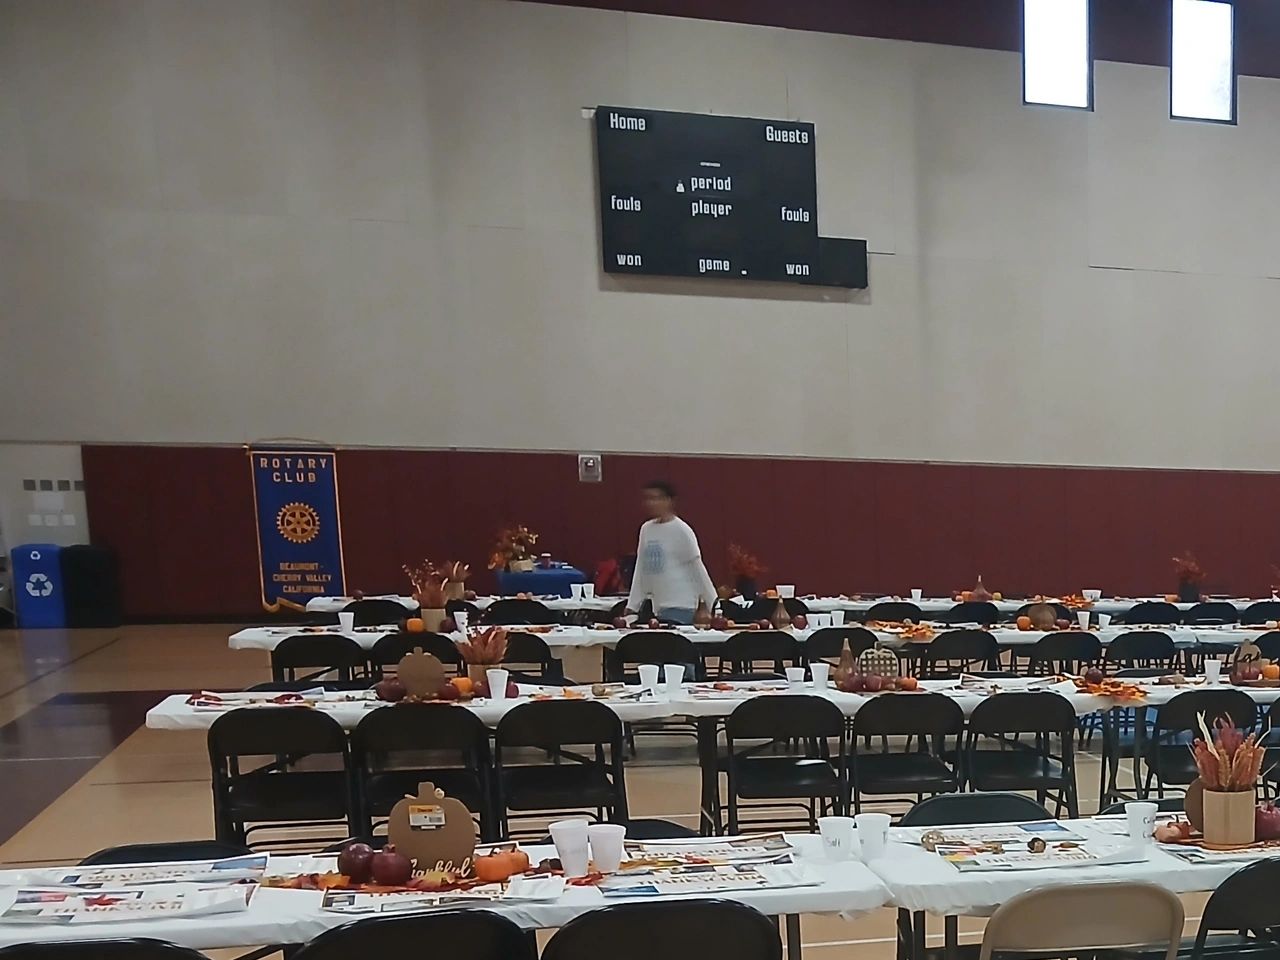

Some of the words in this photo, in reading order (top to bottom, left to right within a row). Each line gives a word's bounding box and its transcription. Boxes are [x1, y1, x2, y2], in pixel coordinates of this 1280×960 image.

[610, 112, 647, 131] Home
[766, 125, 809, 144] Guests
[690, 176, 732, 191] period
[611, 195, 641, 212] fouls
[691, 199, 732, 217] player
[781, 206, 810, 222] fouls
[617, 252, 642, 266] won
[699, 258, 730, 273] game
[786, 262, 810, 276] won
[260, 457, 328, 469] ROTARY
[272, 472, 317, 483] CLUB
[272, 574, 302, 582] CHERRY
[305, 574, 332, 582] VALLEY
[282, 584, 325, 593] CALIFORNIA
